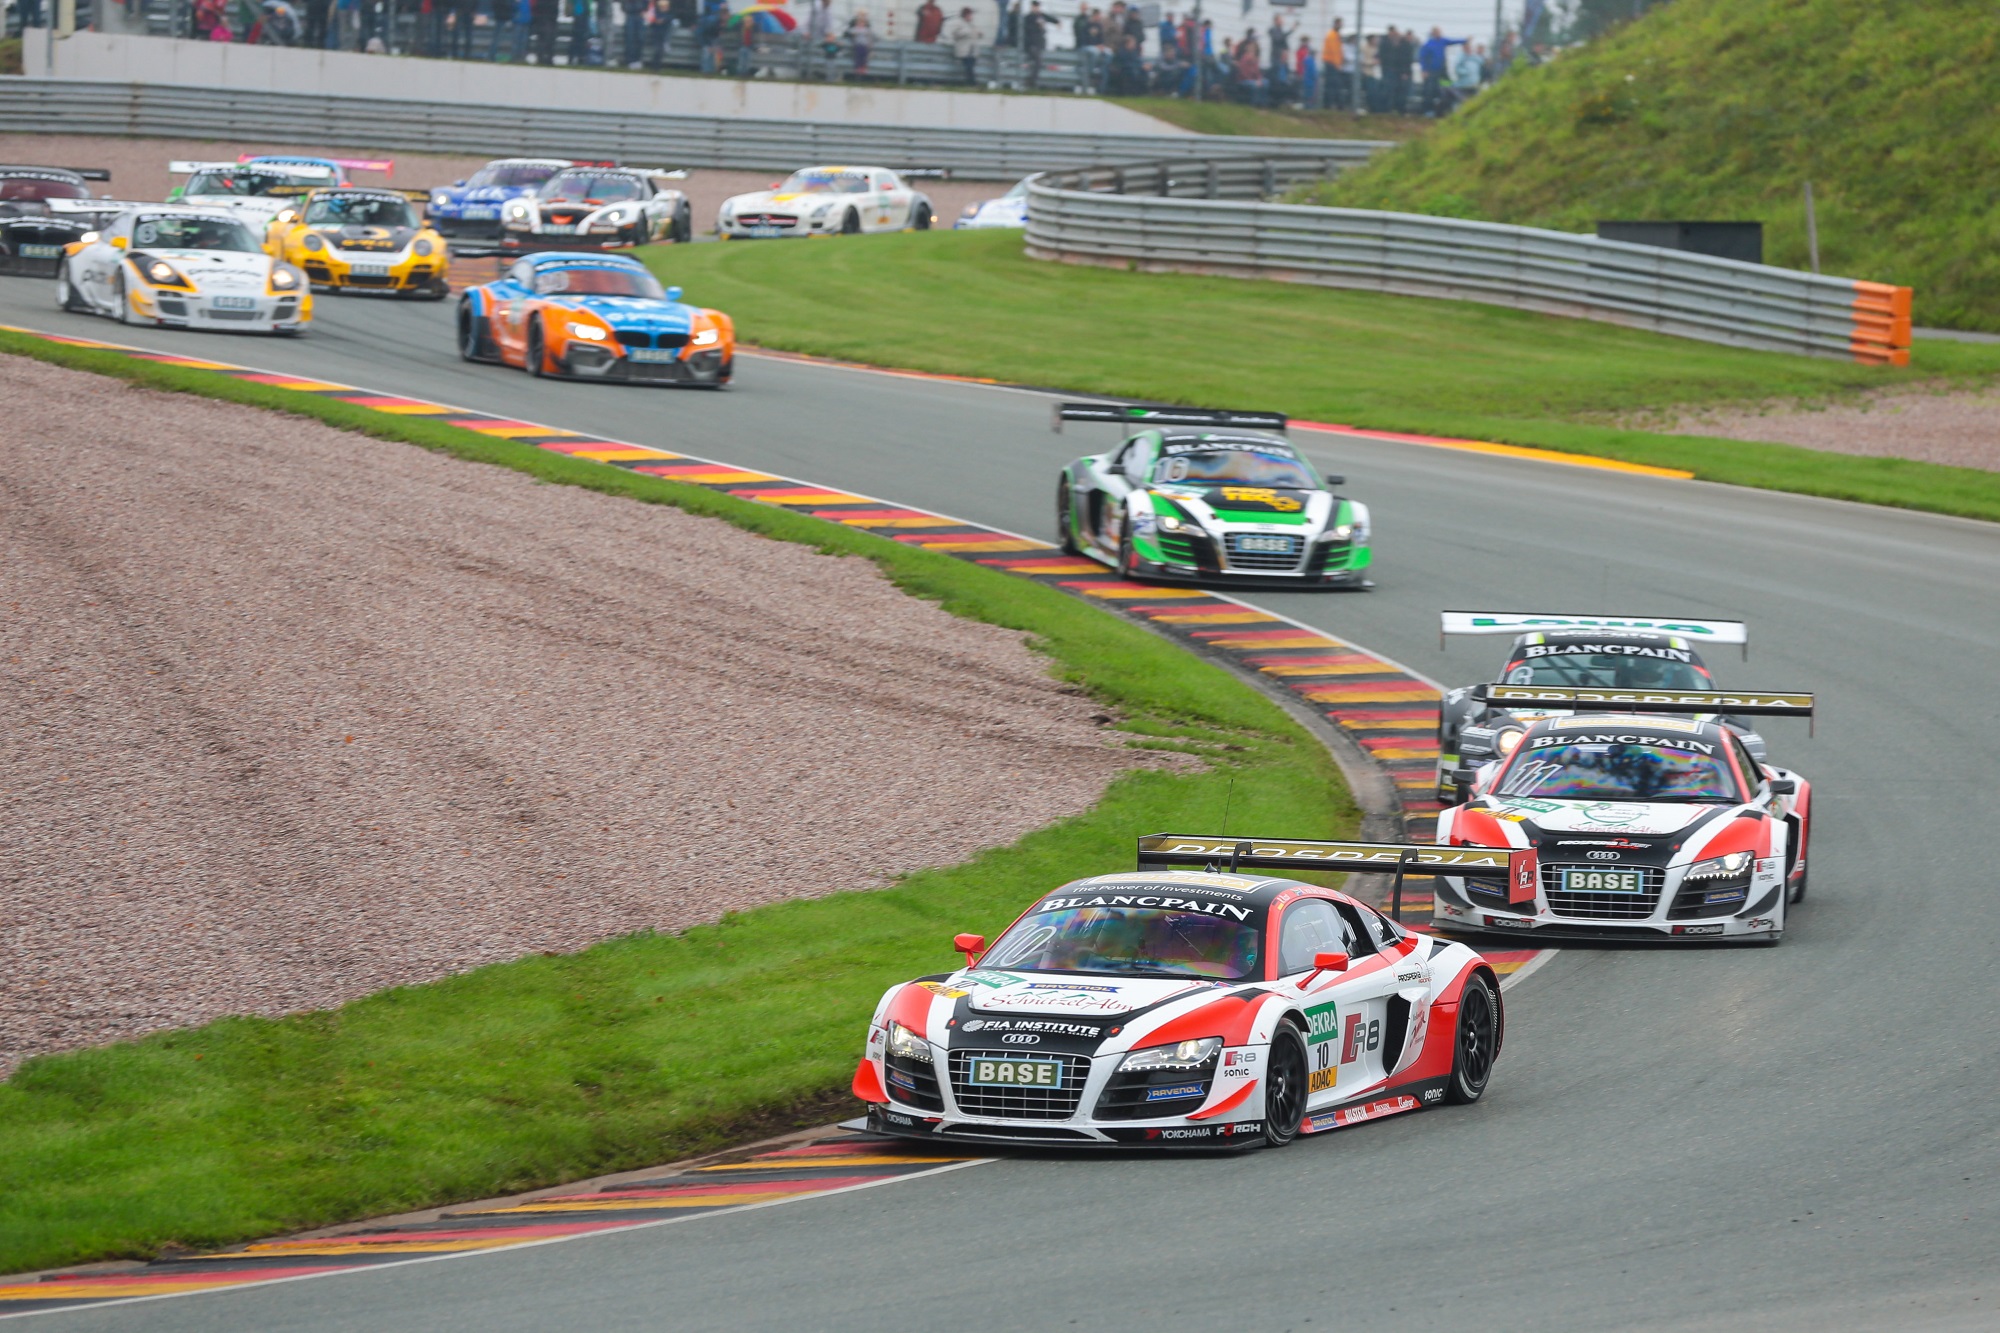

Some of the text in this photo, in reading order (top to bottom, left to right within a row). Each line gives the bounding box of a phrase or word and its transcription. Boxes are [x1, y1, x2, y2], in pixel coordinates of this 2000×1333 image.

[1166, 443, 1296, 458] BLANCPAIN
[1154, 457, 1191, 483] 16
[1241, 538, 1288, 551] BASE
[1525, 645, 1692, 662] BLANCPAIN
[1530, 735, 1716, 755] BLANCPAIN
[1499, 760, 1563, 797] 11
[1570, 872, 1636, 890] BASE
[1161, 886, 1244, 902] Investments
[1038, 896, 1253, 921] BLANCPAIN
[981, 923, 1058, 967] 10
[1033, 983, 1112, 992] RAVENOL
[983, 1020, 1101, 1036] FIA INSTITUTE
[1307, 1010, 1338, 1038] DEKRA
[1350, 1019, 1380, 1058] R8
[1231, 1052, 1256, 1065] R8
[1317, 1042, 1329, 1070] 10
[979, 1062, 1053, 1084] BASE
[1311, 1069, 1332, 1092] ADAC
[1152, 1086, 1200, 1097] RAVENOL
[1161, 1128, 1211, 1139] YOKOHAMA
